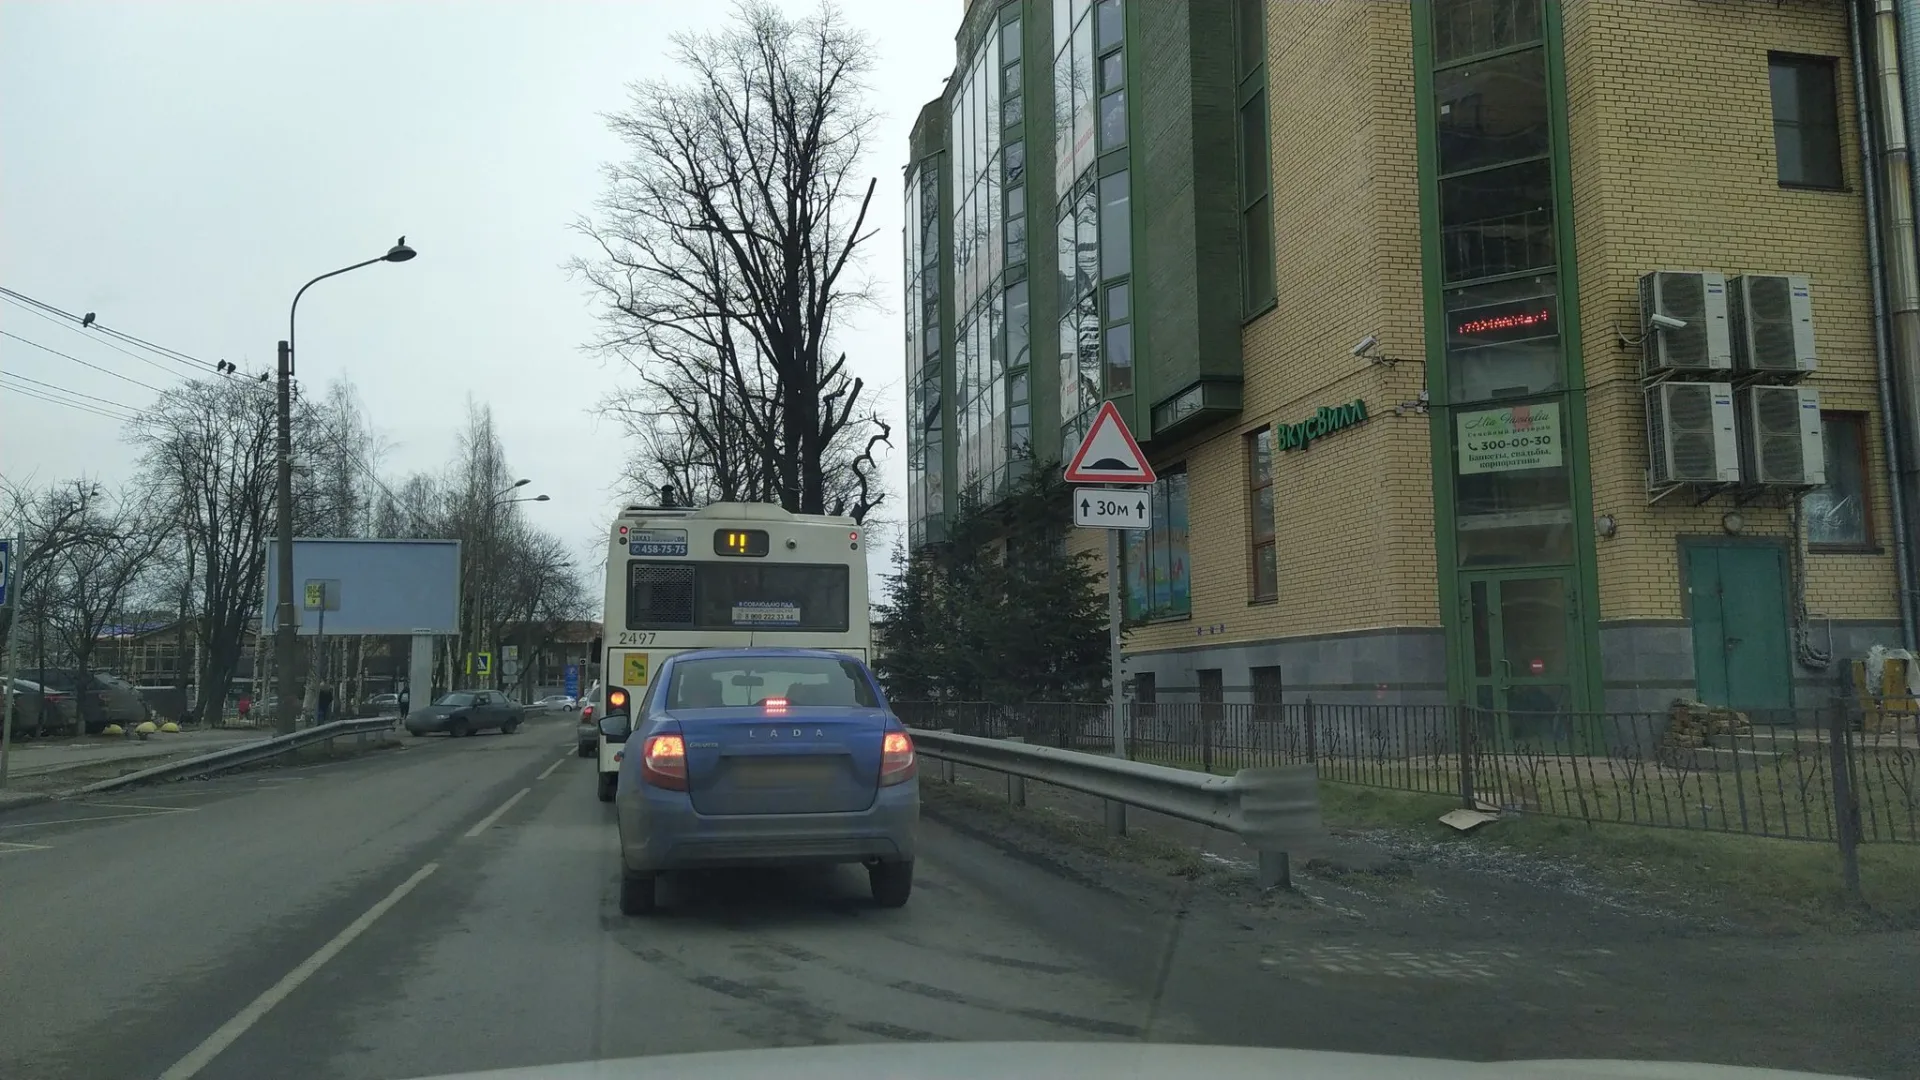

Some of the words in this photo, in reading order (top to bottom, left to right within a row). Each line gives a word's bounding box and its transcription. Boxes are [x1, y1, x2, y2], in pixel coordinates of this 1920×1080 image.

[1481, 436, 1551, 450] 300-00-30
[641, 545, 686, 554] 458-75-75
[619, 632, 656, 645] 2497
[749, 728, 824, 738] LADA
